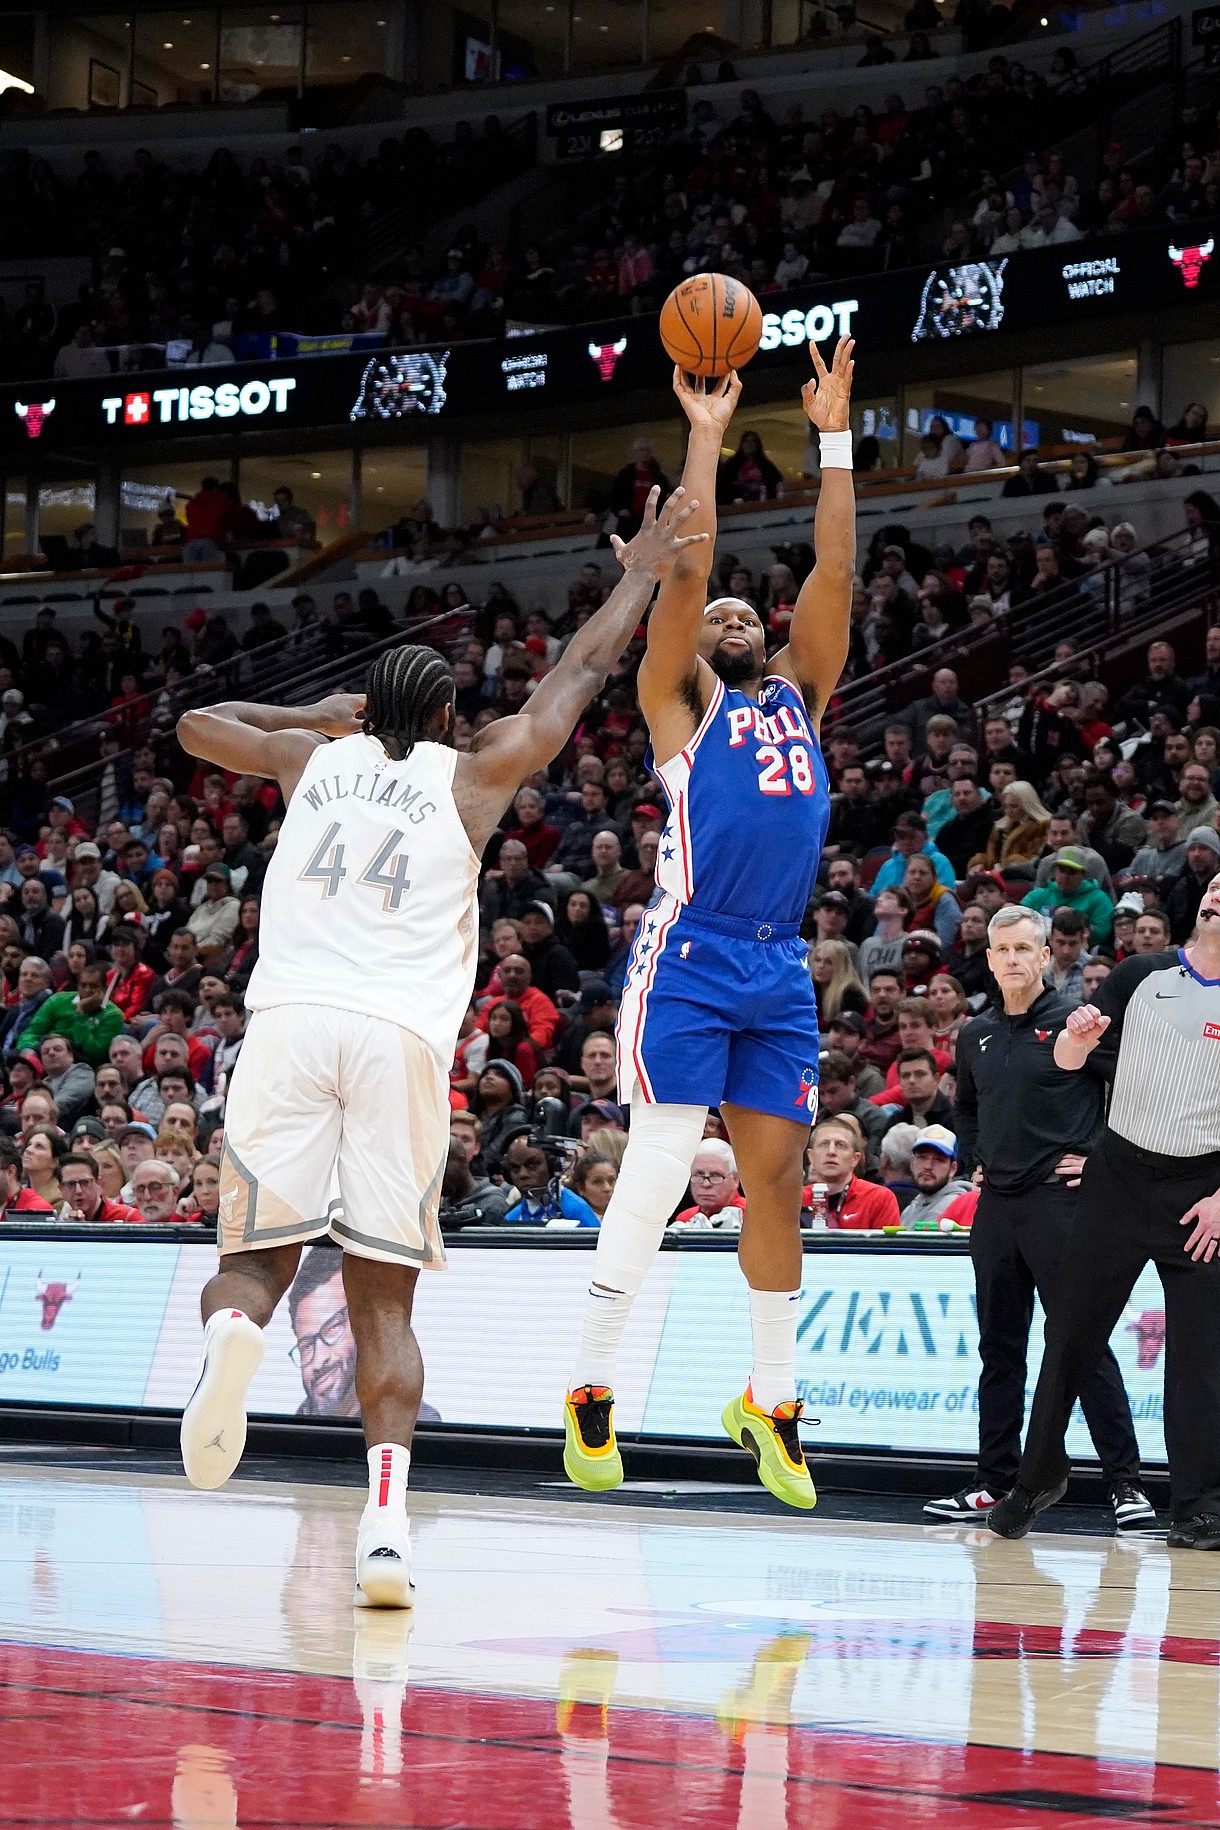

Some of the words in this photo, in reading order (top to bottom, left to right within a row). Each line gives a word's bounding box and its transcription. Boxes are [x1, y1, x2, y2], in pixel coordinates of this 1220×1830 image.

[1067, 277, 1114, 299] WATCH
[153, 377, 297, 422] TISSOT
[756, 746, 816, 796] 28
[302, 773, 437, 825] WILLIAMS
[296, 821, 411, 914] 44
[21, 1347, 61, 1371] Bulls
[849, 1386, 941, 1414] eyewear
[944, 1386, 970, 1413] of
